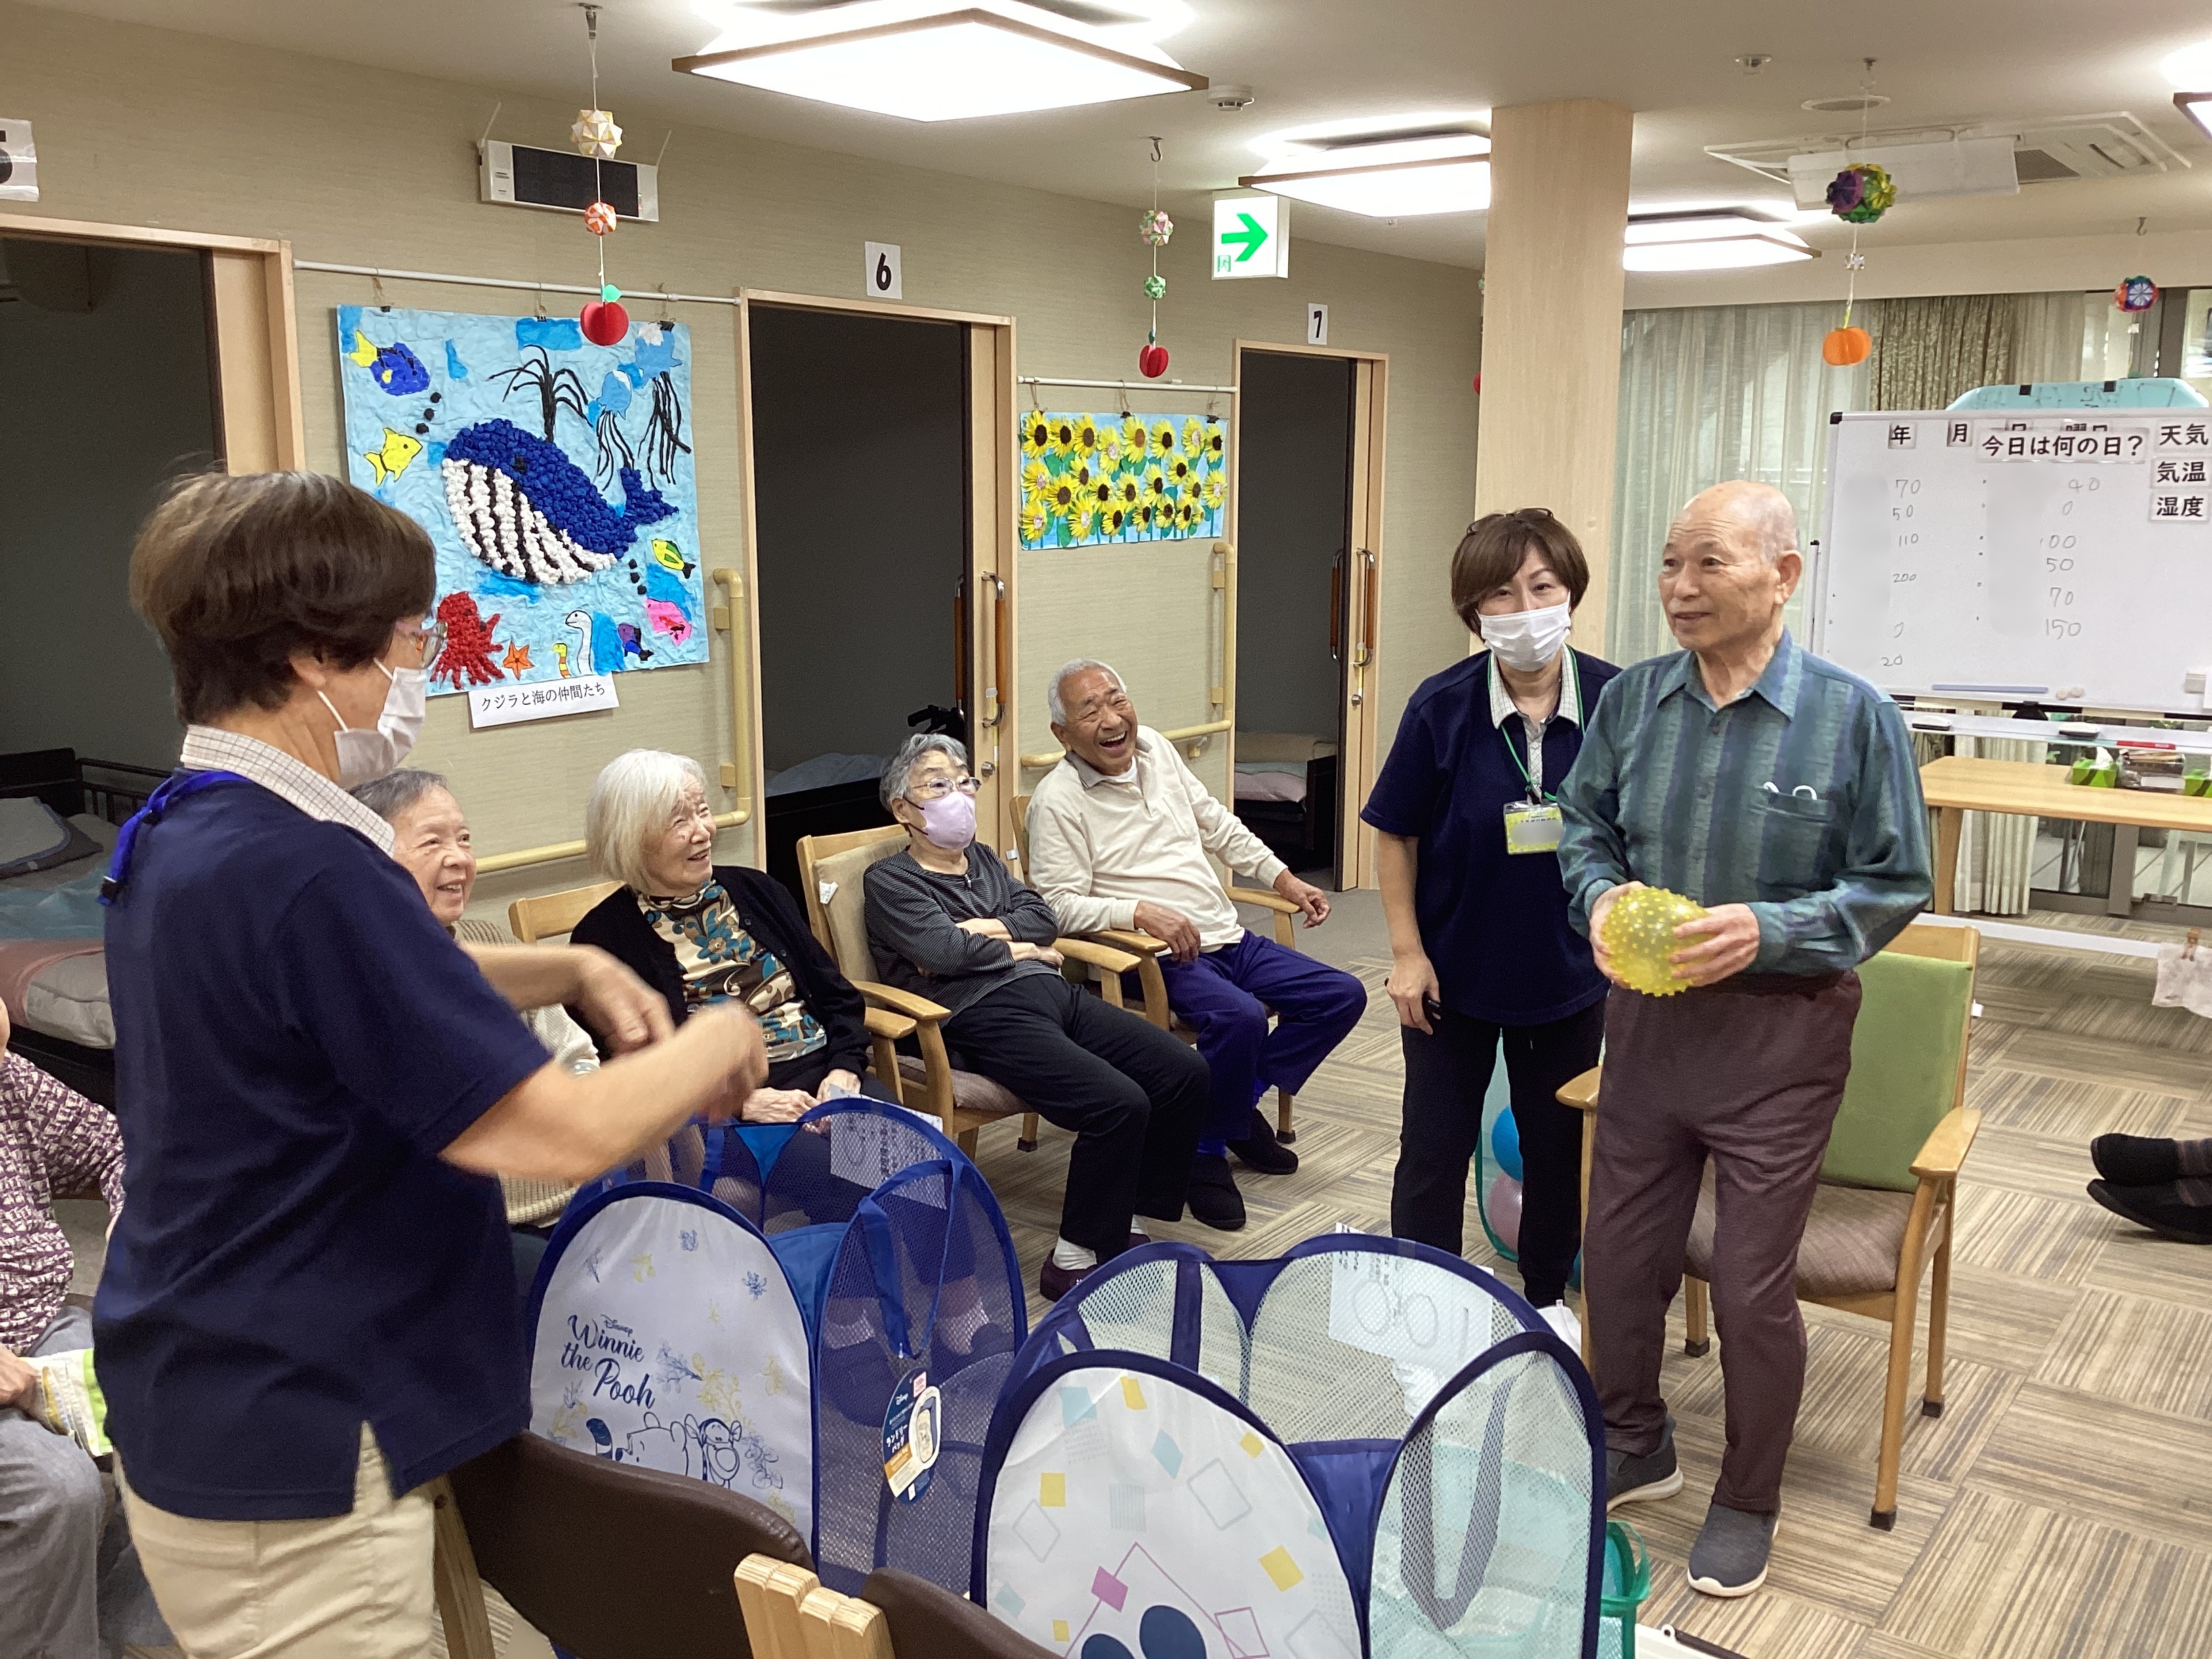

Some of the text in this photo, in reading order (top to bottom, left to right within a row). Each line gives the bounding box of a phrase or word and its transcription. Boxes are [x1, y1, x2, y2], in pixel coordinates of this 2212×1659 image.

[876, 252, 892, 291] 6
[1313, 310, 1322, 338] 7
[1891, 423, 1968, 445] 年 月
[1982, 434, 2144, 456] 今日は何の日？
[2159, 423, 2209, 446] 天気
[2156, 461, 2206, 483] 気温
[1896, 478, 1921, 499] 70
[2068, 476, 2100, 493] 40
[1892, 504, 1914, 521] 50
[2062, 500, 2074, 516] 0
[2156, 495, 2205, 518] 湿度
[1898, 533, 1919, 547] 110
[2046, 557, 2074, 573] 50
[1892, 573, 1917, 583] 200
[2049, 586, 2074, 608] 70
[2045, 618, 2082, 640] 150
[1881, 654, 1903, 667] 20
[481, 682, 606, 712] クジラと海の仲間たち
[567, 1314, 645, 1363] Winnie
[561, 1342, 656, 1410] the Pooh
